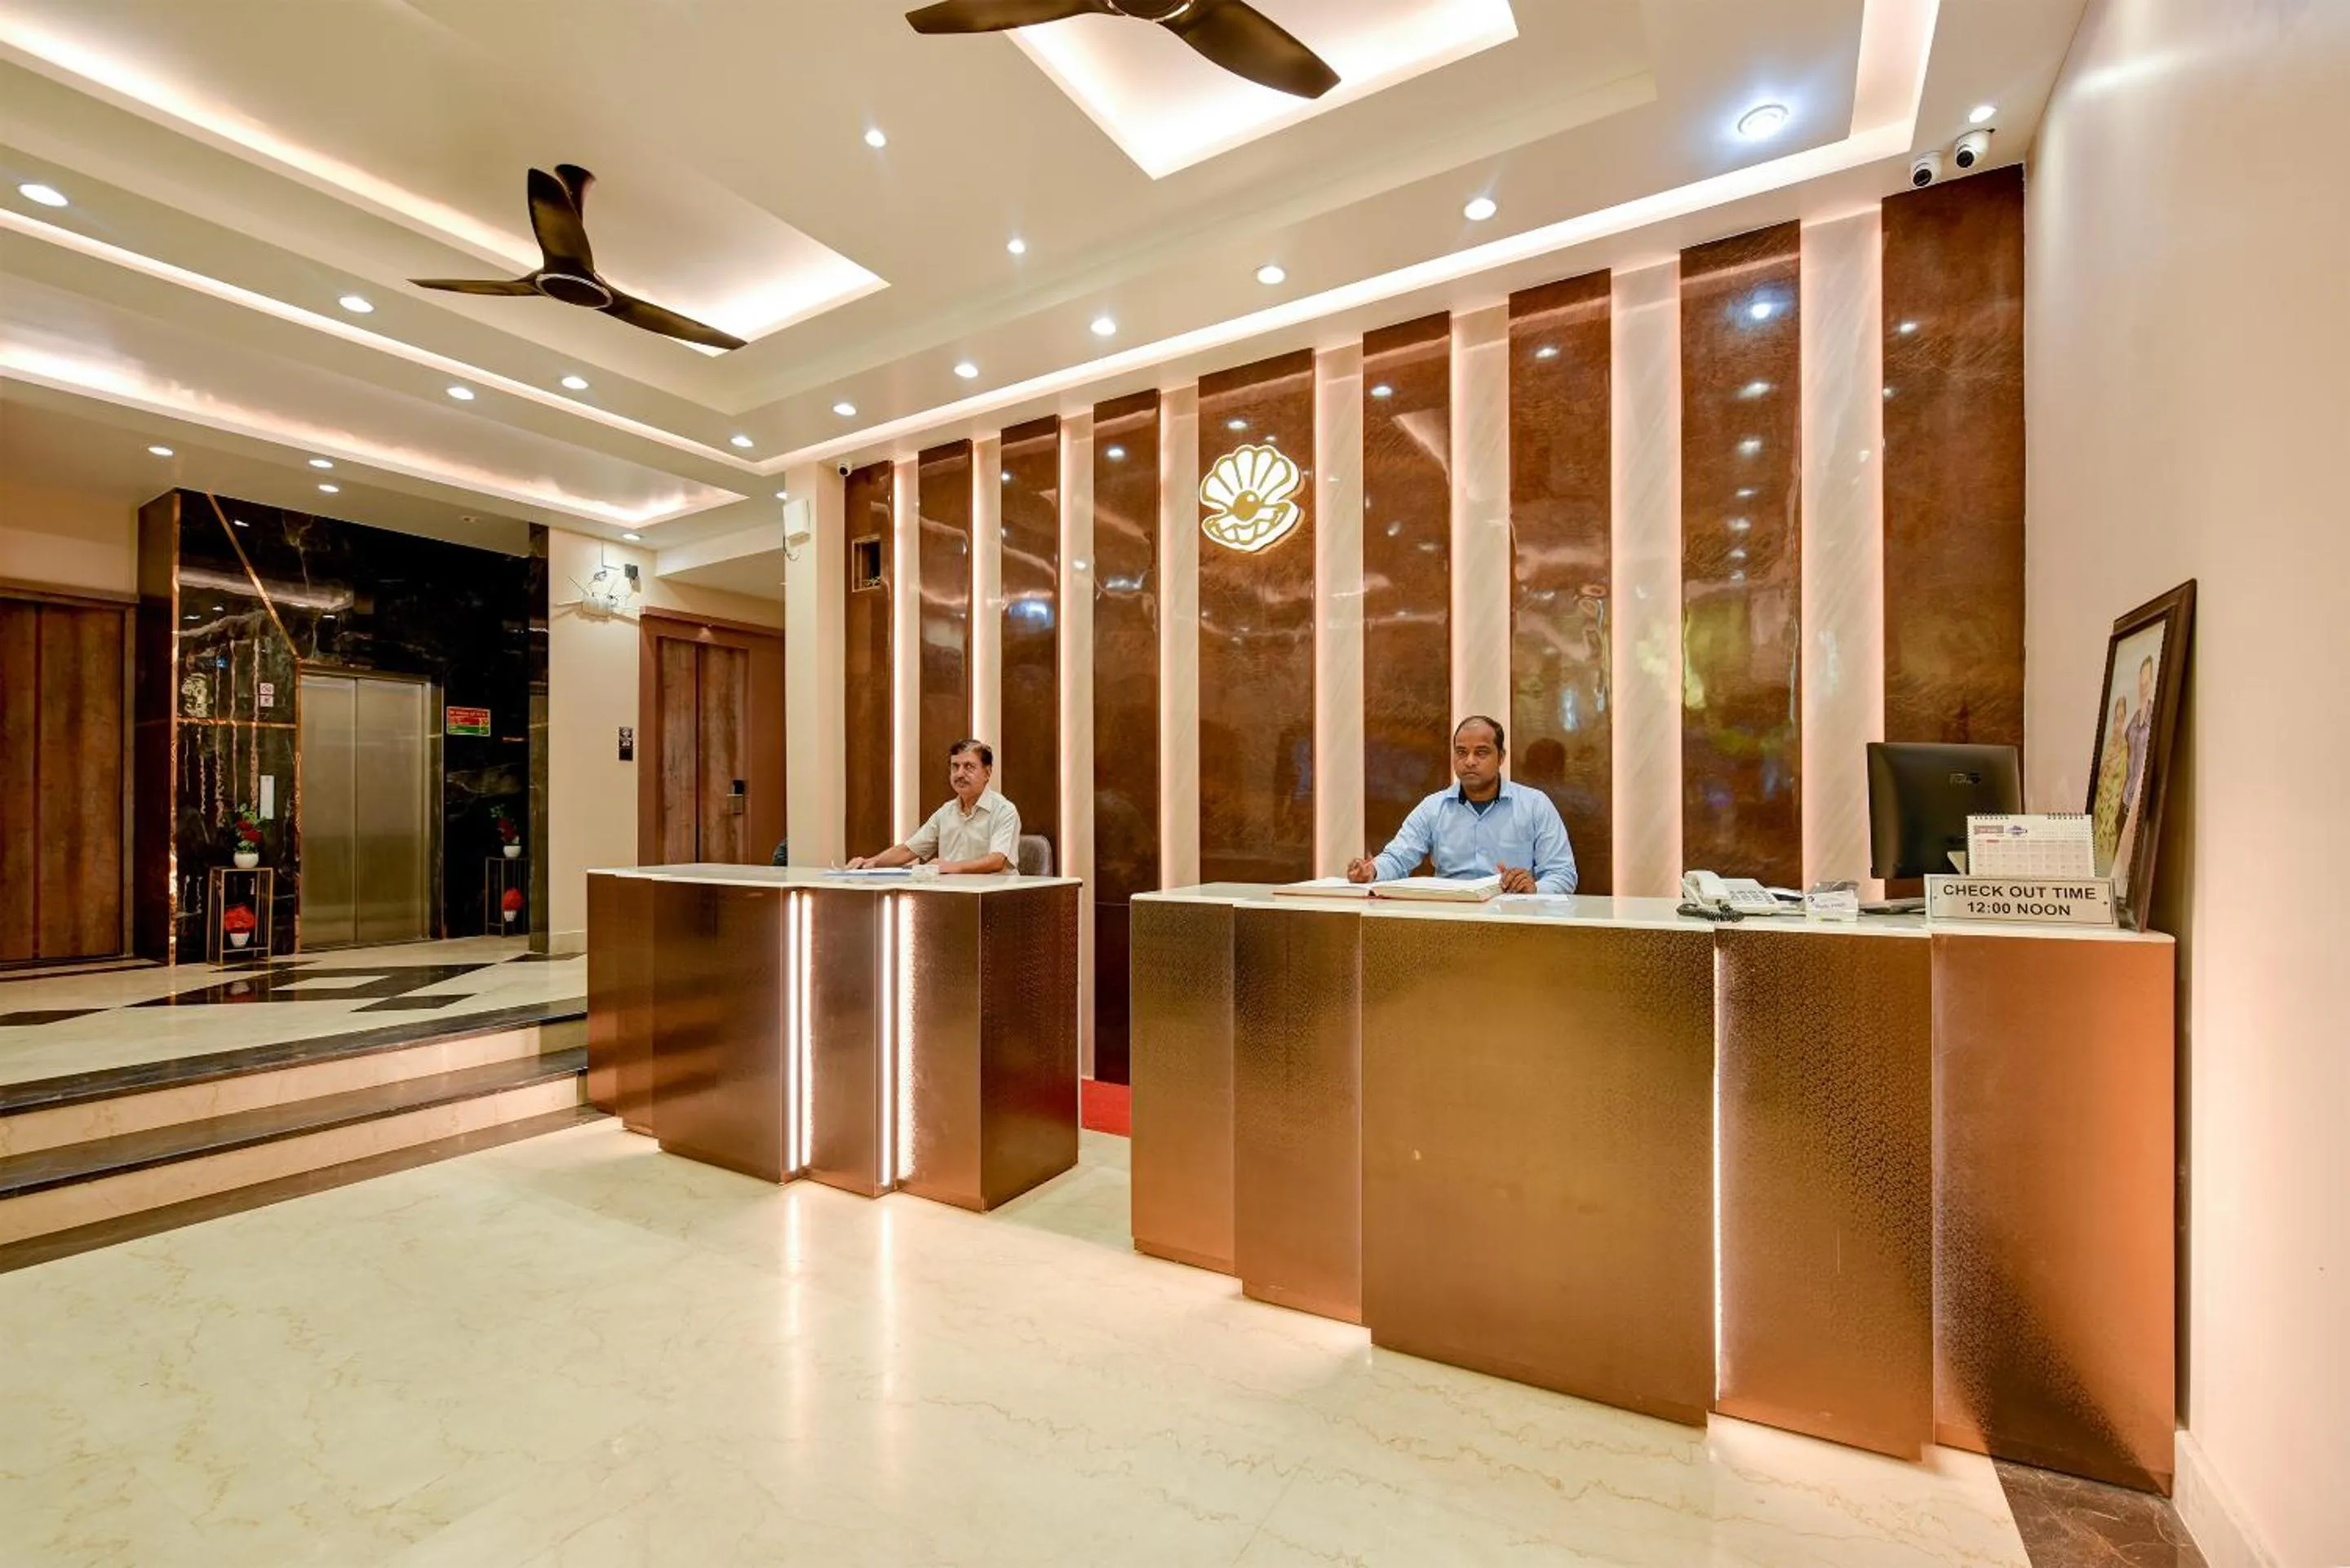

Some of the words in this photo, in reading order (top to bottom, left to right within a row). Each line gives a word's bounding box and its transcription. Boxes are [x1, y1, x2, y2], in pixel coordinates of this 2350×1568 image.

[1943, 884, 2003, 897] CHECK
[2010, 886, 2046, 898] OUT
[2052, 888, 2096, 900] TIME
[1967, 901, 2011, 914] 12:00
[2017, 903, 2070, 915] NOON
